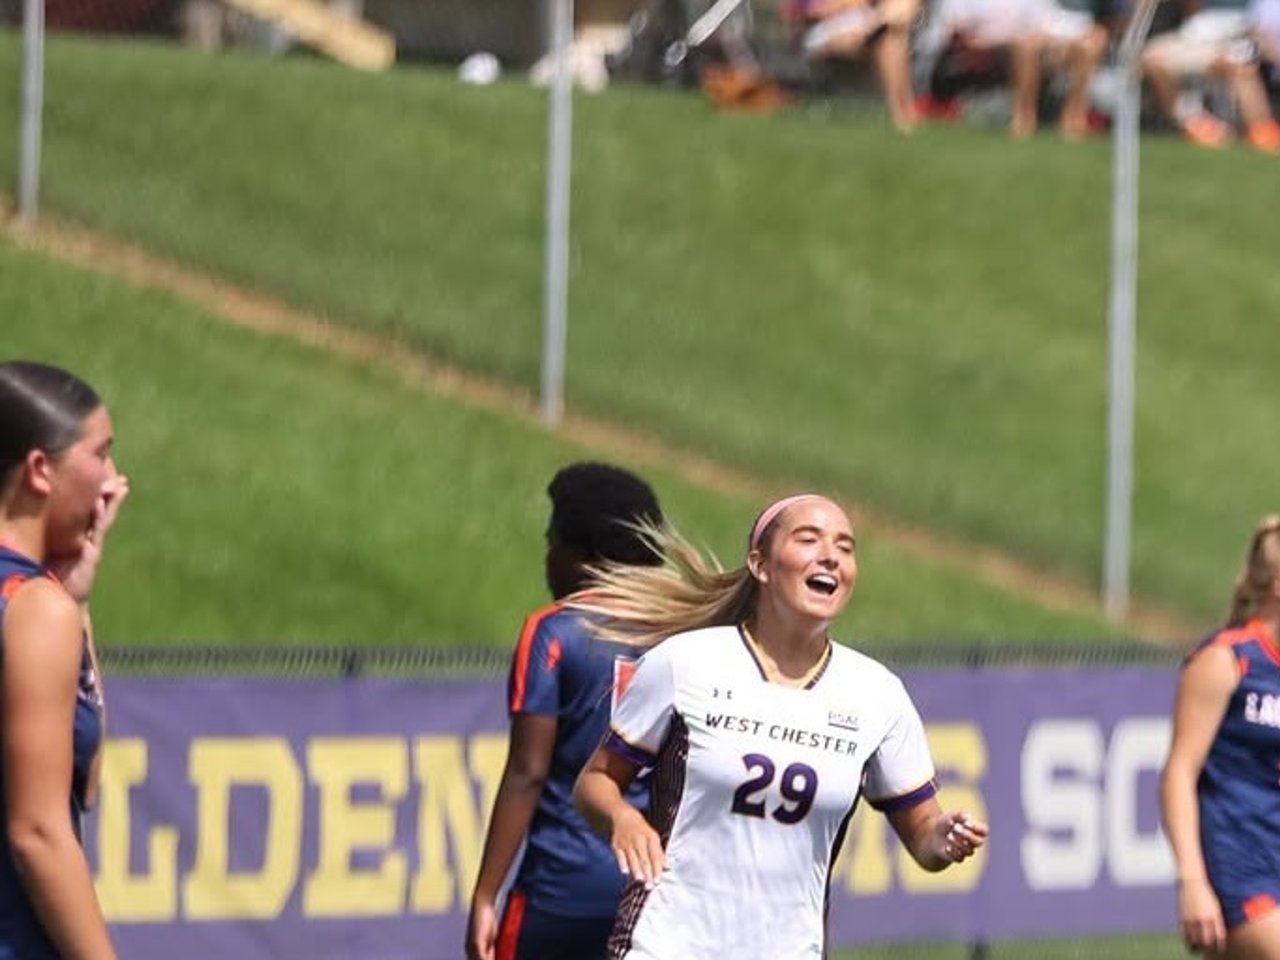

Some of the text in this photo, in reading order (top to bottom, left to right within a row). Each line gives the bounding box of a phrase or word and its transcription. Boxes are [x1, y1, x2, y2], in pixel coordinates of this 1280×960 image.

[704, 712, 859, 757] WEST CHESTER
[730, 752, 819, 826] 29
